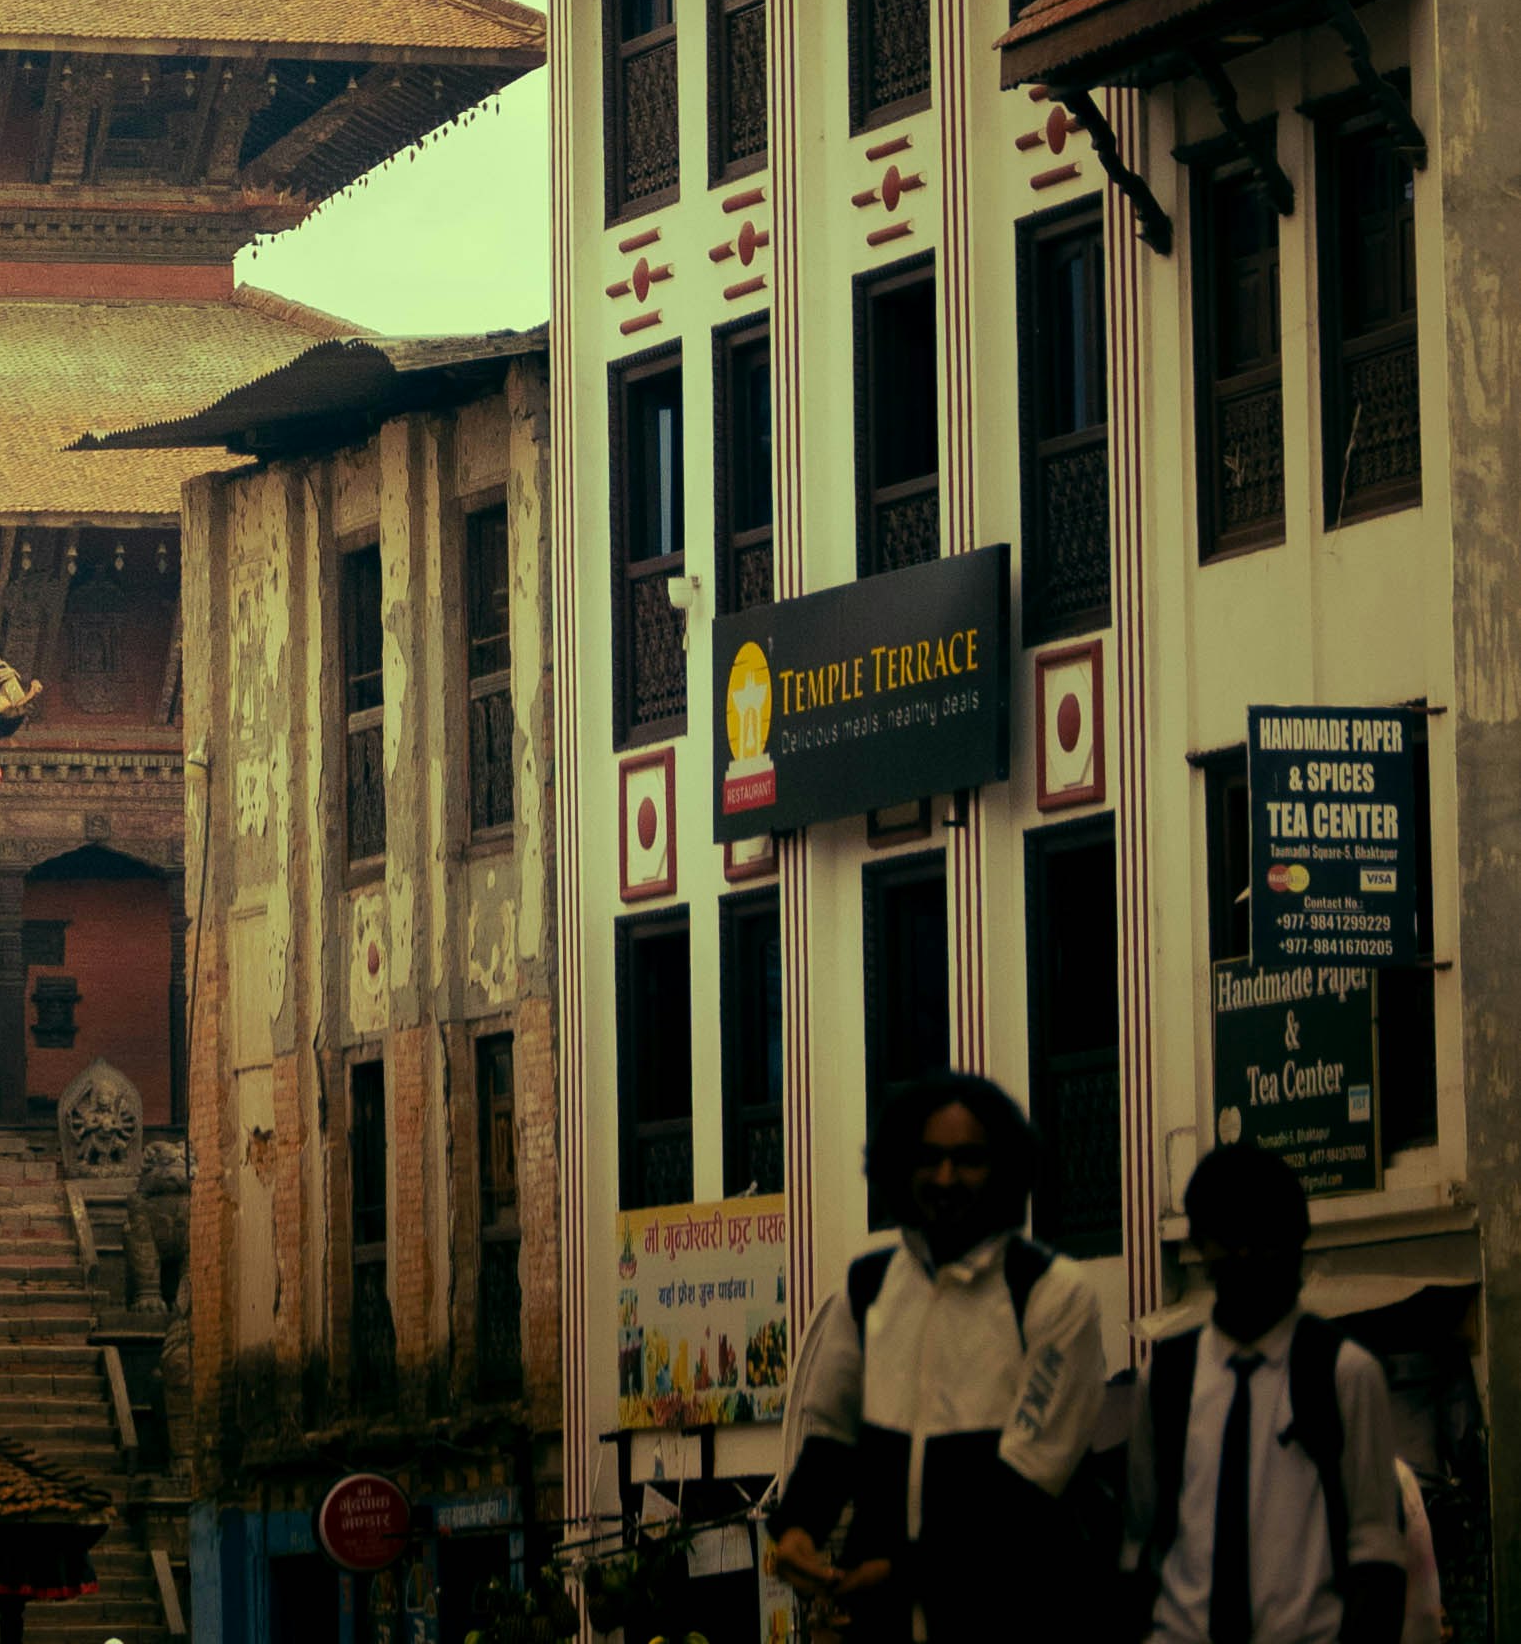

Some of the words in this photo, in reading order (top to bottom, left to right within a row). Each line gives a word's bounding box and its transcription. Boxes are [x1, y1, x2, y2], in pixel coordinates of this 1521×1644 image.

[779, 658, 864, 716] TEMPLE
[871, 628, 979, 693] TERRACE
[1259, 717, 1349, 751] HANDMADE
[1352, 719, 1403, 754] PAPER
[727, 779, 772, 805] RESTAURANT
[1288, 764, 1304, 791] &
[1307, 761, 1375, 793] SPICES
[1266, 802, 1309, 838] TEA
[1313, 803, 1399, 840] CENTER
[1365, 872, 1393, 885] VISA
[1303, 895, 1342, 909] Contact
[1217, 966, 1313, 1012] Handmade
[1283, 1008, 1302, 1052] &
[1246, 1064, 1279, 1107] Tea
[1282, 1058, 1345, 1102] Center
